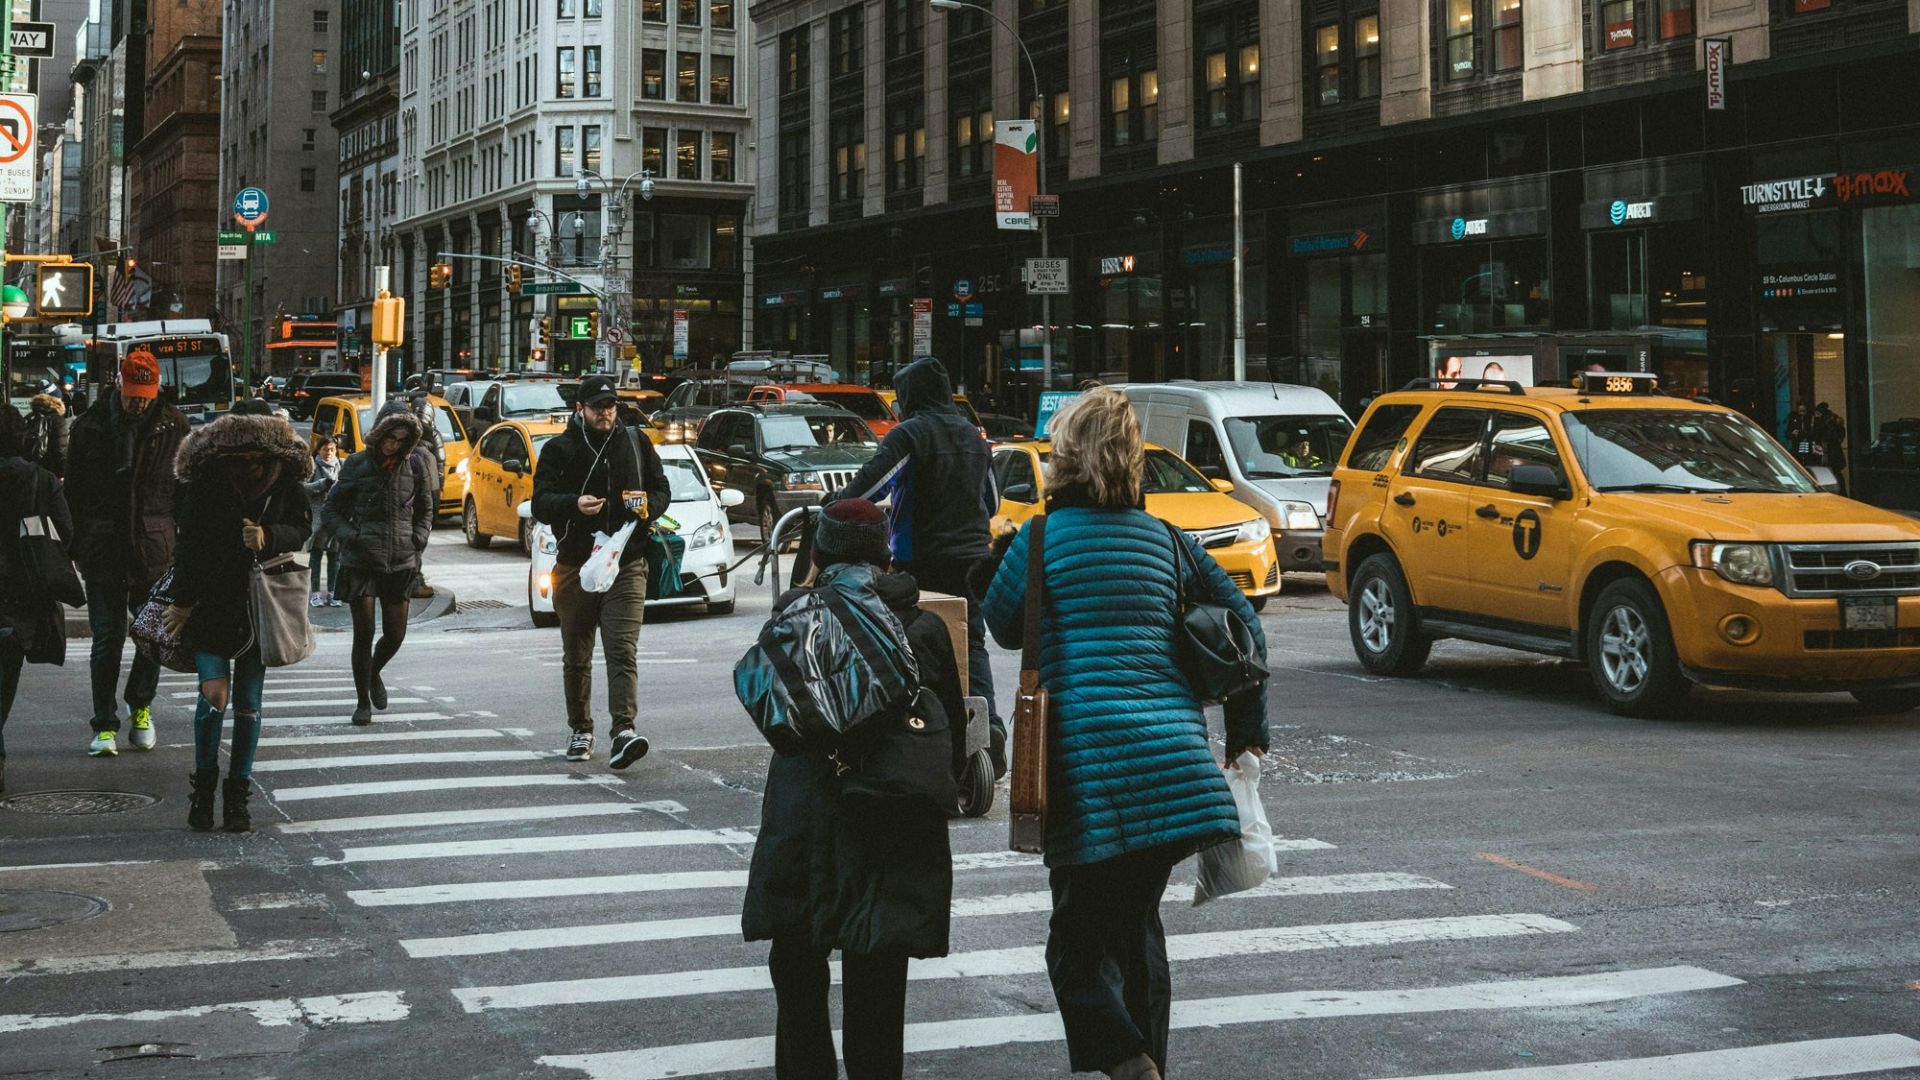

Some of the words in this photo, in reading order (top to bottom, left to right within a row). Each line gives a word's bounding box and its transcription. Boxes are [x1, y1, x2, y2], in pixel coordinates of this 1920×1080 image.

[1740, 178, 1814, 205] TURNSTYLE
[1626, 202, 1653, 219] AT&T
[1758, 202, 1791, 213] UNDERGROUND
[1792, 200, 1810, 210] MARKET
[1465, 219, 1488, 235] AT&T
[1779, 274, 1803, 283] Columbus
[1804, 273, 1818, 281] Circle
[1819, 272, 1837, 281] Station
[177, 342, 187, 352] 57
[191, 341, 202, 351] ST
[1605, 377, 1633, 392] 5B56
[1041, 395, 1060, 411] BEST
